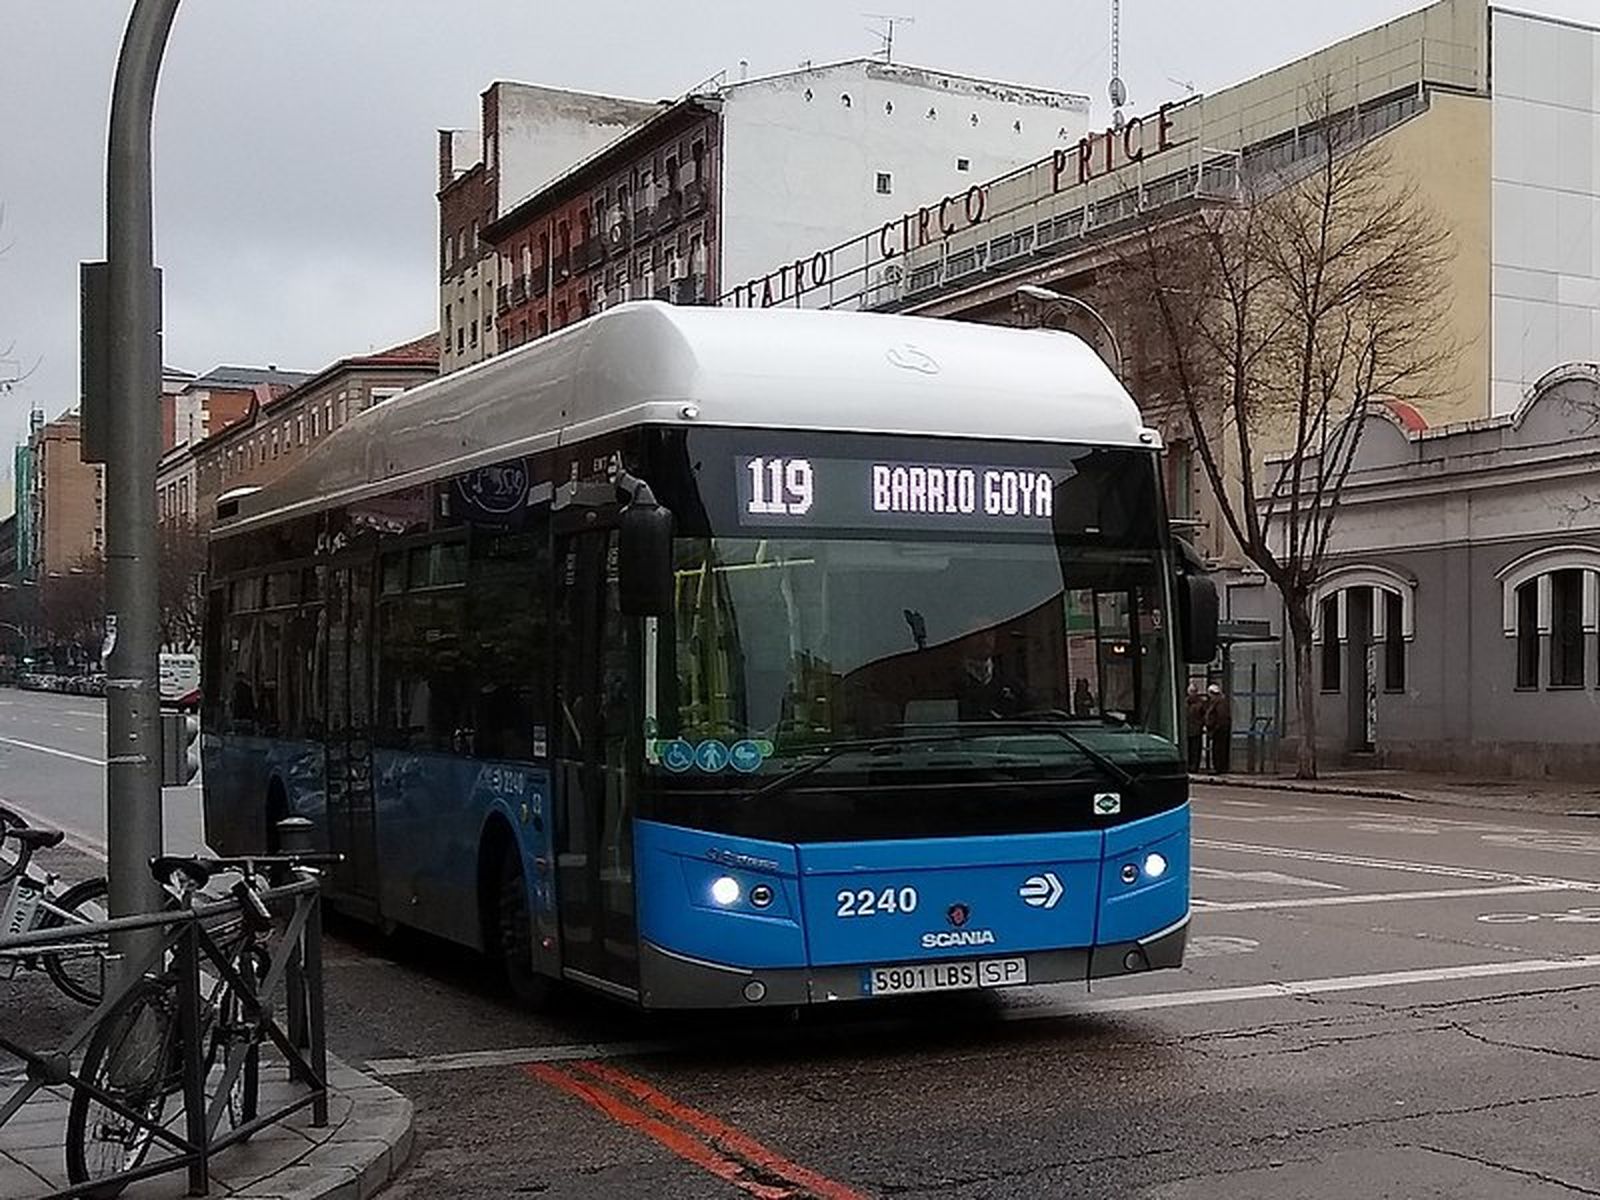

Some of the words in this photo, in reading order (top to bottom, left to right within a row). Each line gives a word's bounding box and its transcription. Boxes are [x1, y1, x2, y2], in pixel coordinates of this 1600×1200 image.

[733, 251, 827, 308] TEATRO
[879, 185, 985, 260] CIRCO
[1052, 102, 1177, 195] PRICE
[747, 456, 814, 515] 119
[872, 464, 976, 514] BARRIO
[983, 470, 1053, 517] GOYA
[836, 887, 918, 918] 2240
[921, 930, 996, 949] SCANIA
[876, 968, 927, 992] 5901
[934, 965, 973, 987] LBS
[985, 961, 1020, 982] SP
